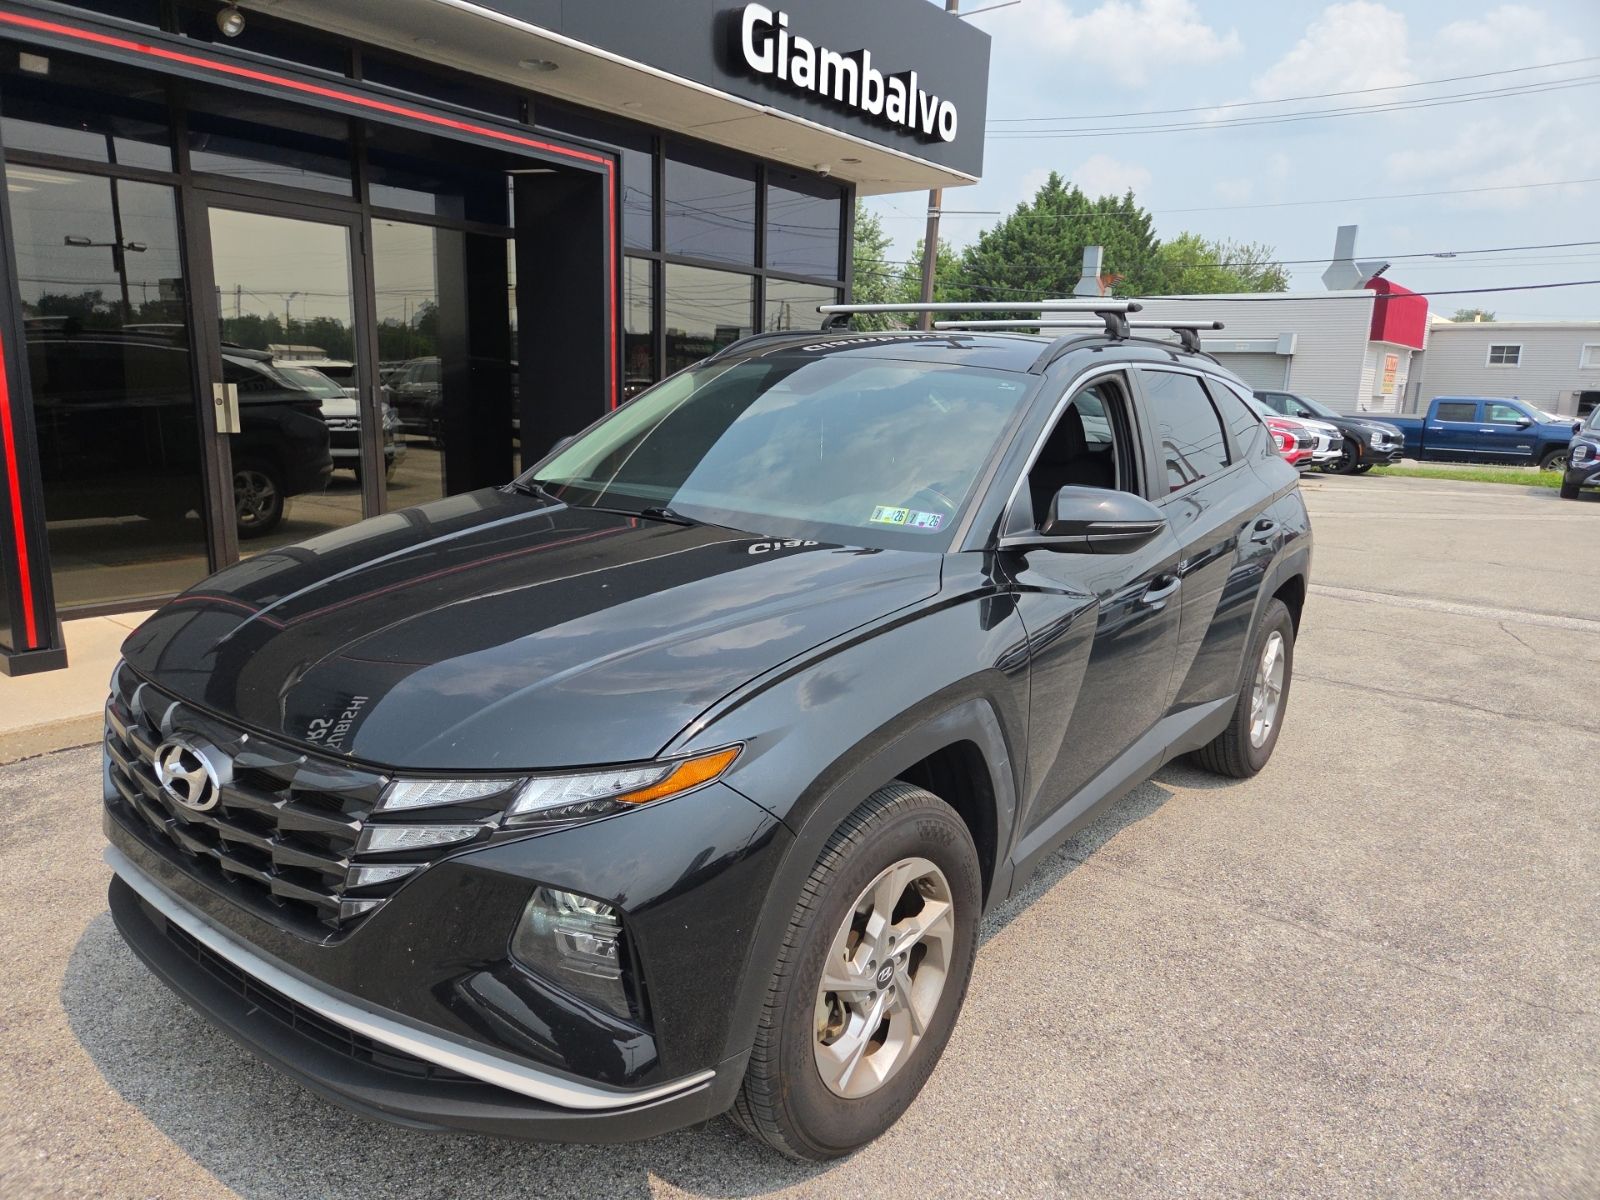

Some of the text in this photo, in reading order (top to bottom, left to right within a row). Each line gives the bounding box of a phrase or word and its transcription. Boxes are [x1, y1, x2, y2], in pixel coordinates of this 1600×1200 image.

[742, 3, 958, 143] Giambalvo
[894, 510, 905, 522] 26
[929, 515, 940, 527] 26
